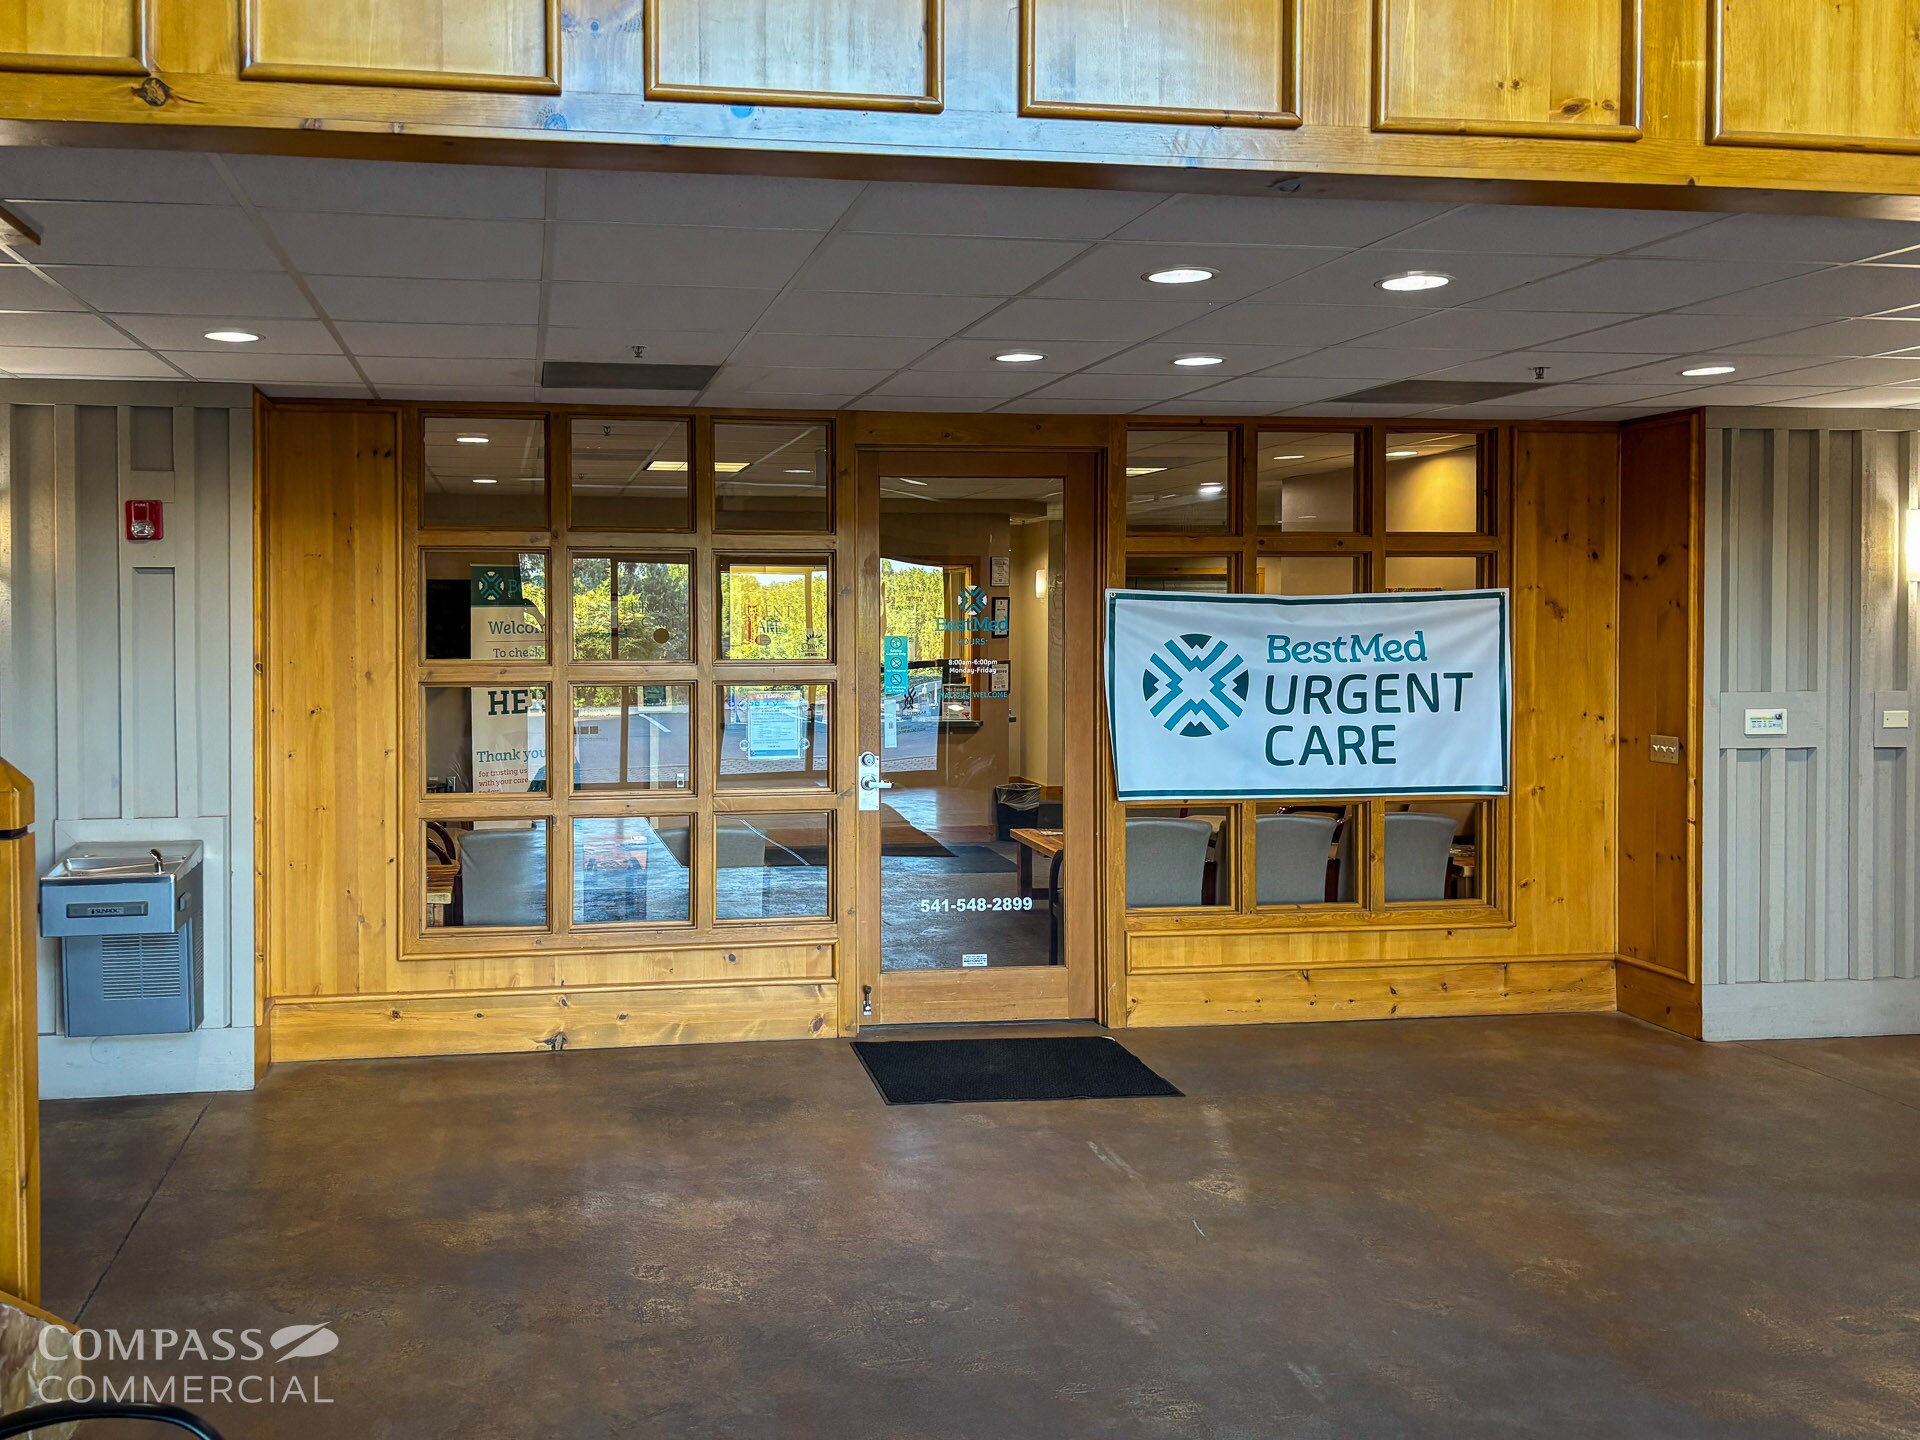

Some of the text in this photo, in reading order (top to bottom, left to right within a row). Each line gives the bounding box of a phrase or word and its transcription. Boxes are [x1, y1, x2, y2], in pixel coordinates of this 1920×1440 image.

[935, 616, 1009, 632] BestMed
[493, 648, 506, 658] To
[1266, 630, 1428, 664] BestMed
[948, 659, 998, 667] 8:00am-6:00pm
[949, 667, 997, 675] Monday-Friday
[1264, 671, 1474, 715] URGENT
[1265, 723, 1397, 767] CARE
[476, 749, 521, 762] Thank
[478, 770, 489, 778] for
[490, 768, 518, 777] trusting
[478, 779, 496, 787] with
[496, 779, 512, 787] your
[920, 897, 1033, 913] 541-548-2899
